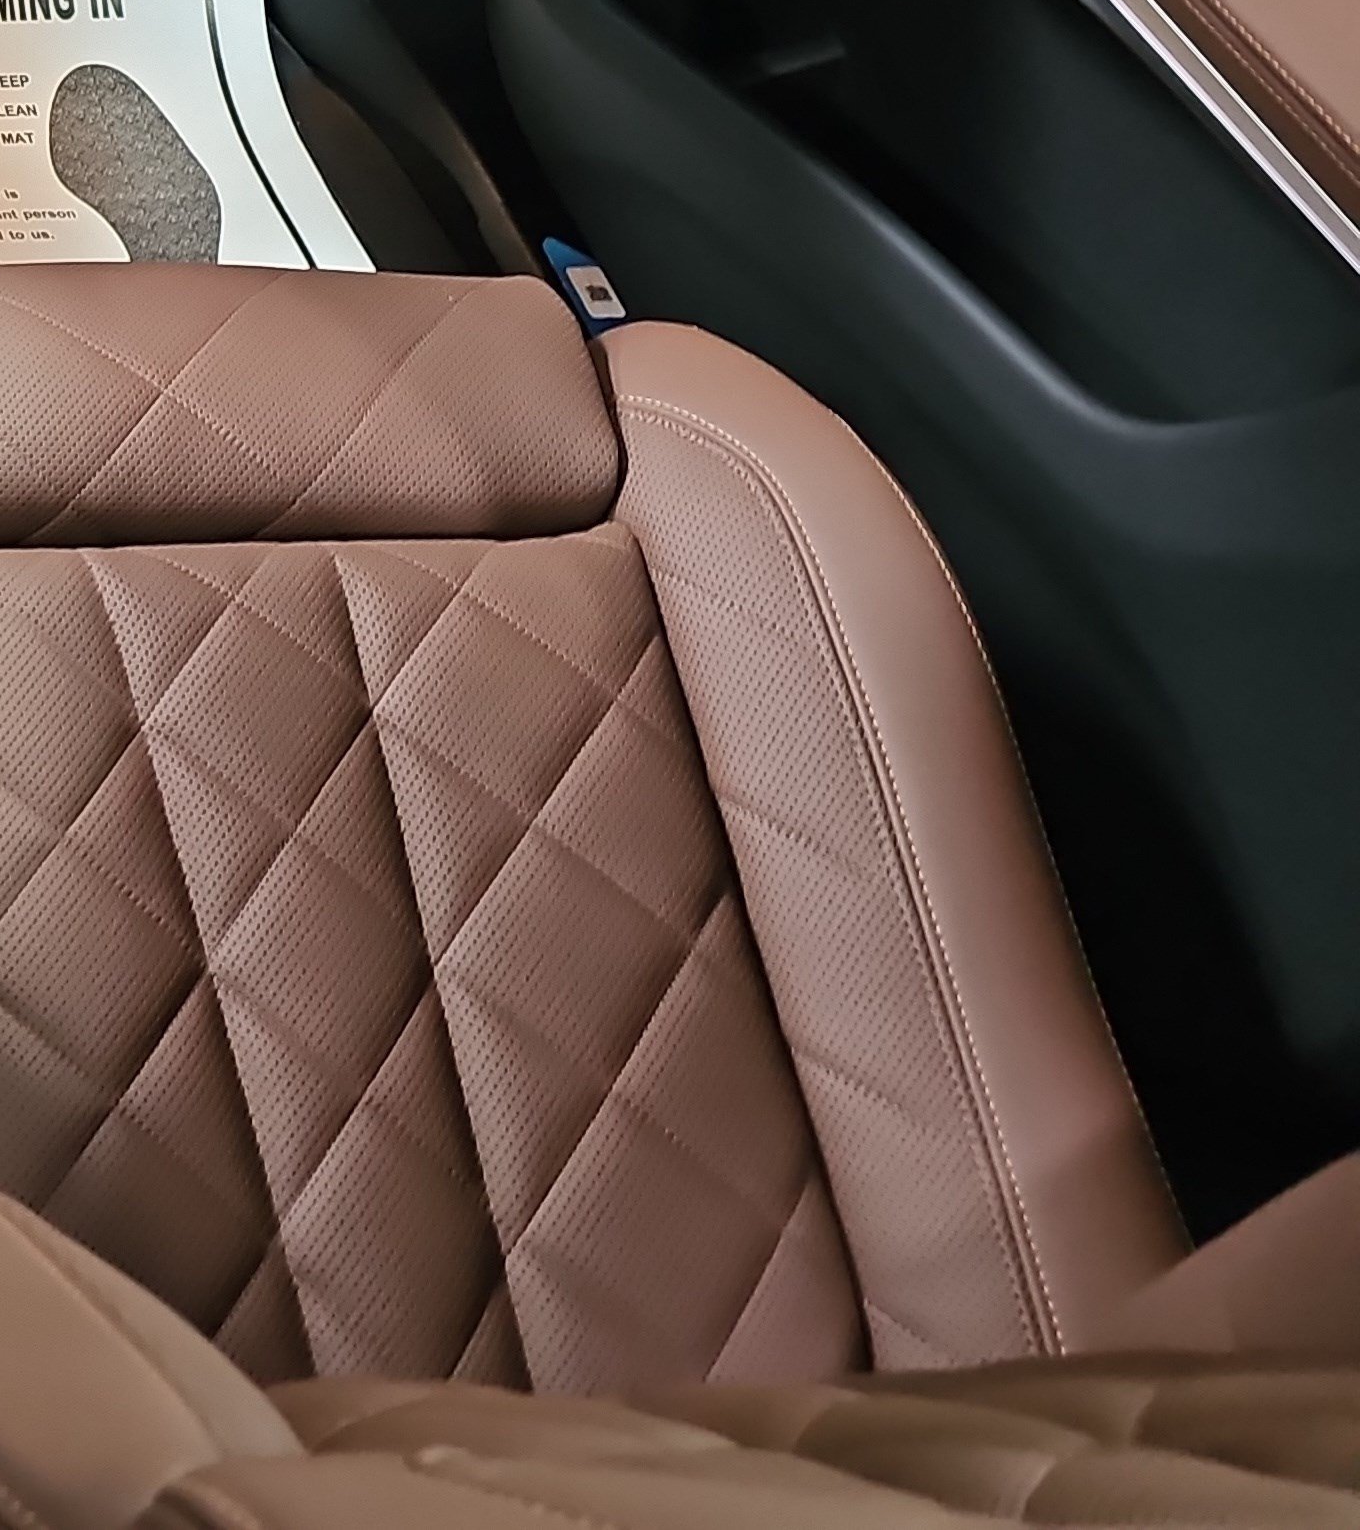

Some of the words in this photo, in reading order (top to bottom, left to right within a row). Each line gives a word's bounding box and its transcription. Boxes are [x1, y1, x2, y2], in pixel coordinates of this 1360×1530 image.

[1, 131, 34, 145] MAT
[4, 188, 19, 200] is
[23, 209, 76, 221] person
[8, 230, 25, 241] to
[30, 231, 56, 241] us.
